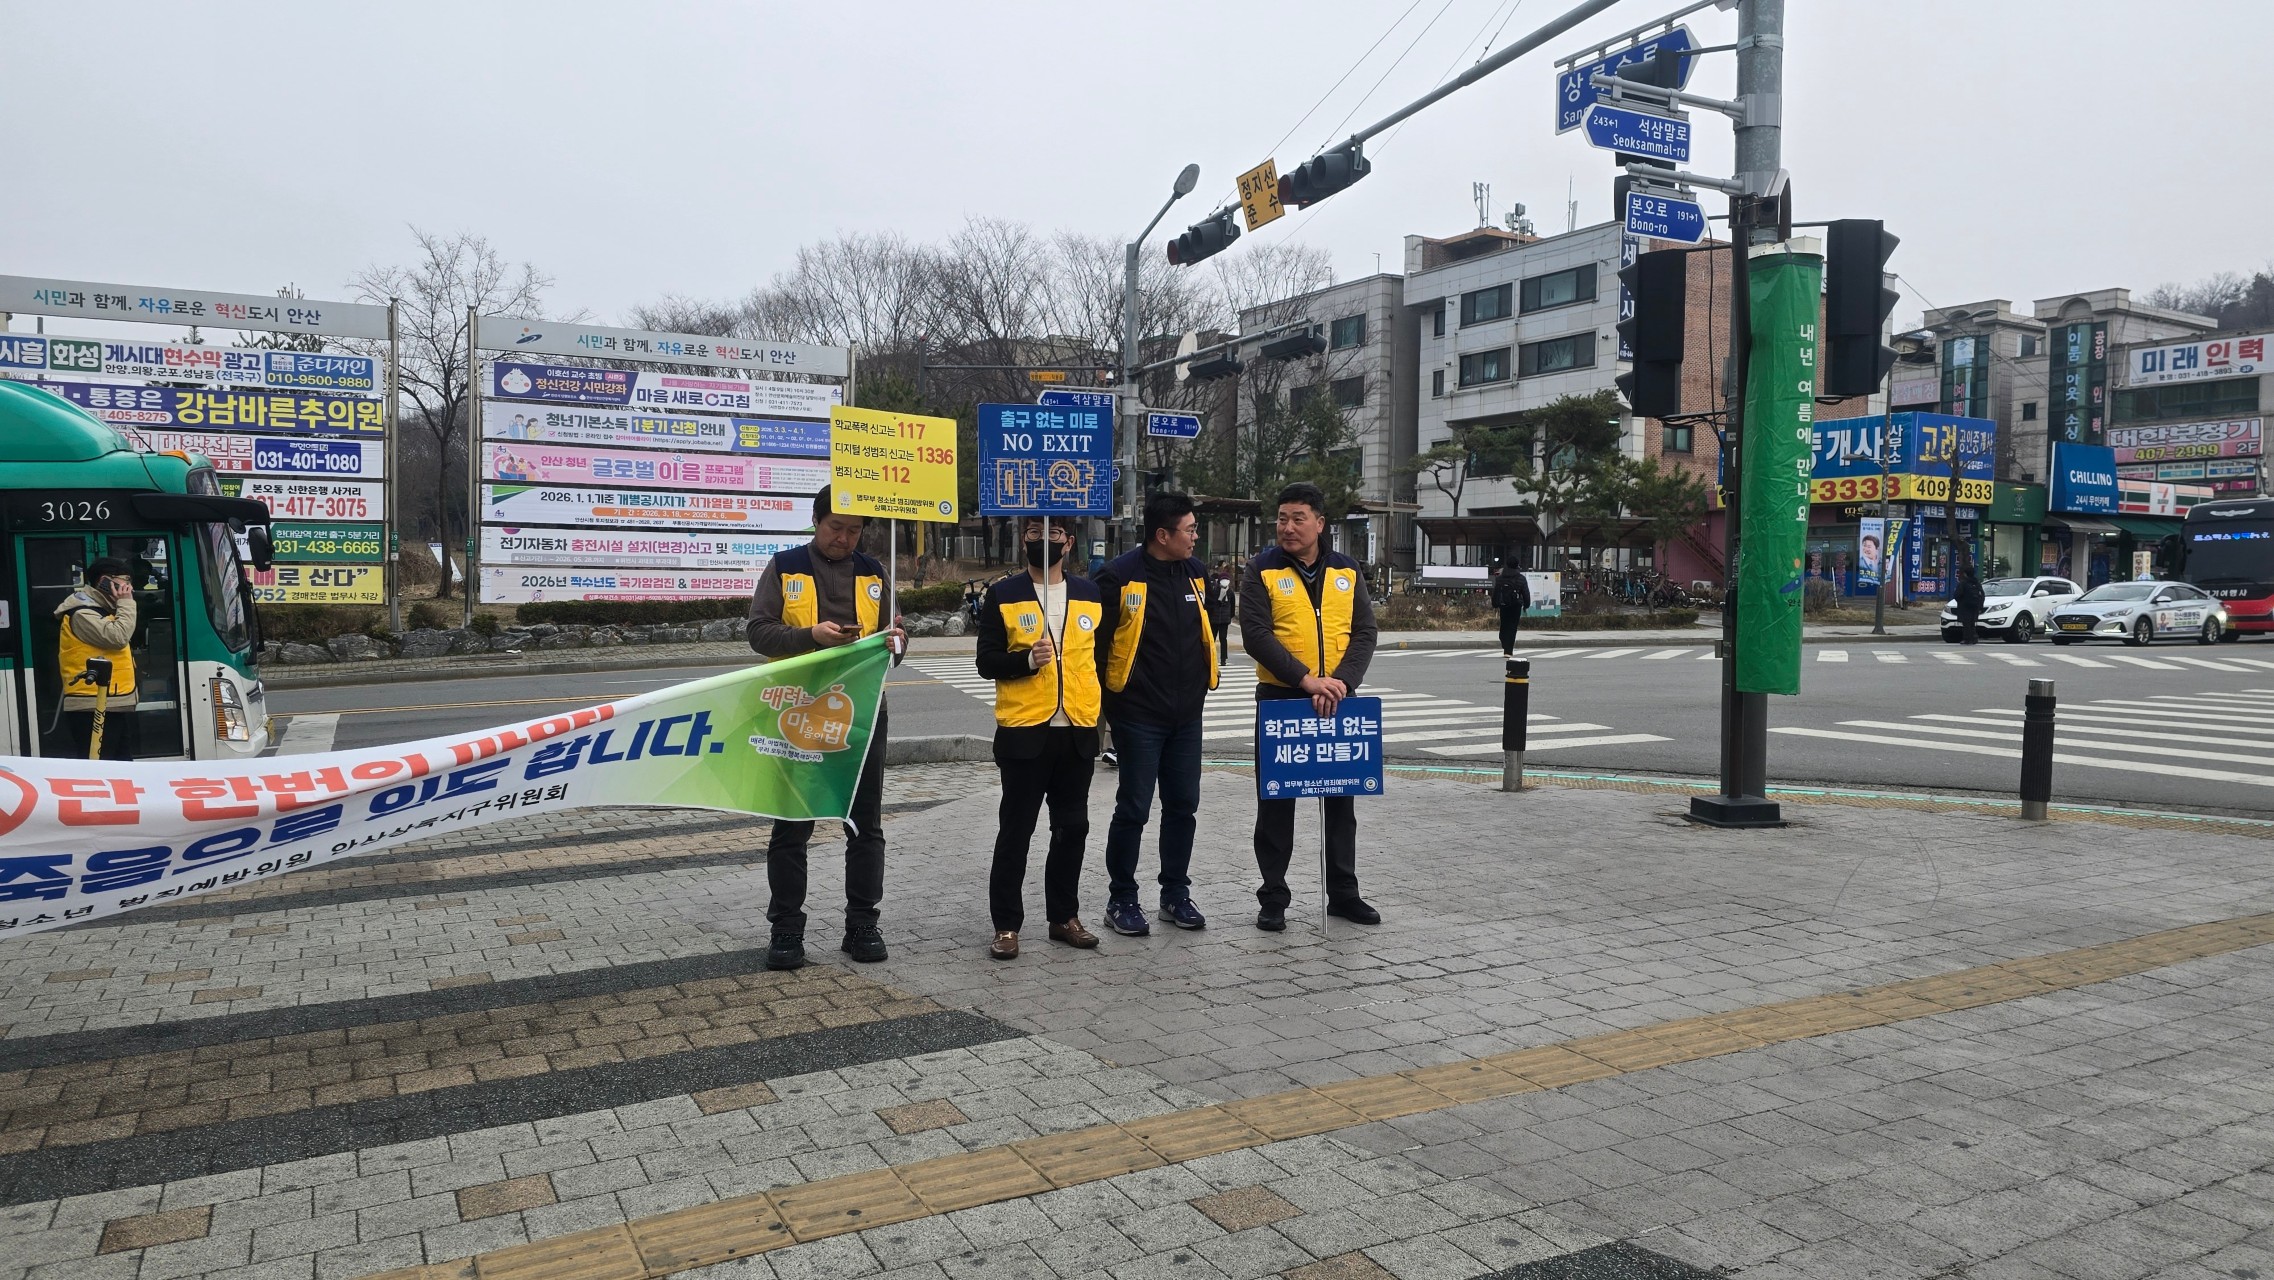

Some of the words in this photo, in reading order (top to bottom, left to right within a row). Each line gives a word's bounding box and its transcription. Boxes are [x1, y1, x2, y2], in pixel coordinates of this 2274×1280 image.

[1639, 118, 1687, 142] 석삼말로
[1613, 133, 1685, 158] Seoksammal-ro
[1241, 166, 1275, 200] 정지선
[1631, 197, 1667, 217] 본오로
[1631, 217, 1667, 234] Bono-ro
[33, 289, 86, 308] 시민과
[93, 293, 132, 311] 함께,
[138, 297, 206, 317] 자유로운
[215, 302, 279, 322] 혁신도시
[287, 308, 321, 326] 안산
[0, 340, 45, 365] 시흥
[52, 342, 99, 368] 화성
[576, 334, 617, 351] 시민과
[623, 338, 652, 353] 함께,
[657, 341, 709, 358] 자유로운
[715, 345, 764, 362] 혁신도시
[770, 349, 796, 365] 안산
[1800, 323, 1815, 367] 내년
[297, 356, 367, 376] 준디자인
[571, 370, 586, 379] 교수
[2178, 367, 2232, 379] 031-418-3893
[267, 373, 371, 388] 010-9500-9880
[535, 378, 581, 392] 정신건강
[583, 380, 627, 395] 시민강좌
[637, 388, 668, 403] 마음
[1071, 393, 1112, 406] 석삼말로
[89, 387, 163, 409] 통증은
[176, 392, 383, 432] 강남바른추의원
[108, 410, 168, 422] 405-8275
[1796, 379, 1813, 445] 여름에
[546, 412, 628, 431] 청년기본소득
[633, 418, 668, 434] 1분기
[671, 420, 698, 436] 신청
[700, 422, 725, 437] 안내
[835, 419, 868, 433] 학교폭력
[870, 423, 896, 437] 신고는
[898, 421, 926, 440] 117
[1001, 410, 1030, 429] 출구
[1035, 411, 1065, 429] 없는
[1070, 412, 1098, 430] 미로
[1151, 416, 1179, 427] 본오로
[1151, 427, 1178, 435] Bono-ro
[2110, 418, 2261, 449] 대한보청기
[158, 434, 252, 458] 대행전문
[1002, 433, 1033, 451] NO
[1042, 434, 1093, 453] EXIT
[1919, 424, 1957, 461] 고려
[2236, 441, 2259, 454] 2F
[257, 451, 359, 472] 031-401-1080
[835, 442, 860, 456] 디지털
[862, 446, 887, 459] 성범죄
[889, 448, 914, 461] 신고는
[917, 446, 954, 465] 1336
[541, 455, 563, 467] 안산
[565, 456, 587, 468] 청년
[592, 457, 655, 480] 글로벌
[659, 461, 700, 482] 이음
[704, 464, 744, 475] 프로그램
[835, 465, 852, 478] 범죄
[854, 467, 879, 481] 신고는
[882, 465, 910, 484] 112
[252, 484, 283, 494] 본오동
[287, 485, 328, 496] 신한은행
[332, 486, 361, 496] 사거리
[704, 475, 727, 484] 참가자
[729, 476, 743, 485] 모집
[1795, 458, 1811, 522] 만나요
[617, 493, 686, 508] 개별공시지가
[689, 496, 733, 510] 지가열람
[737, 497, 747, 510] 및
[750, 498, 793, 511] 의견제출
[856, 494, 876, 502] 법무부
[877, 496, 896, 505] 청소년
[874, 504, 918, 514] 상록지구위원회
[41, 501, 111, 522] 3026
[276, 530, 312, 539] 한대앞역
[314, 530, 328, 539] 2번
[329, 531, 347, 539] 출구
[348, 532, 362, 540] 5분
[363, 532, 380, 540] 거리
[273, 540, 380, 555] 031-438-6665
[500, 536, 568, 551] 전기자동차
[571, 538, 624, 553] 충전시설
[627, 540, 712, 555] 설치(변경)신고
[716, 542, 728, 555] 및
[731, 542, 779, 556] 책임보험
[1911, 514, 1922, 579] 고려부동산
[521, 575, 567, 588] 2026년
[570, 576, 616, 588] 짝수년도
[619, 576, 675, 589] 국가암검진
[677, 578, 687, 589] &
[690, 578, 754, 590] 일반건강검진
[292, 591, 328, 600] 경매전문
[331, 592, 357, 601] 법무사
[361, 592, 378, 601] 직강
[762, 687, 815, 710] 배려는
[1264, 717, 1337, 739] 학교폭력
[1342, 716, 1379, 737] 없는
[1274, 743, 1311, 764] 세상
[1316, 741, 1370, 763] 만들기
[1284, 780, 1303, 788] 법무부
[1303, 779, 1323, 787] 청소년
[1301, 787, 1344, 795] 상록지구위원회
[44, 777, 146, 826] 단
